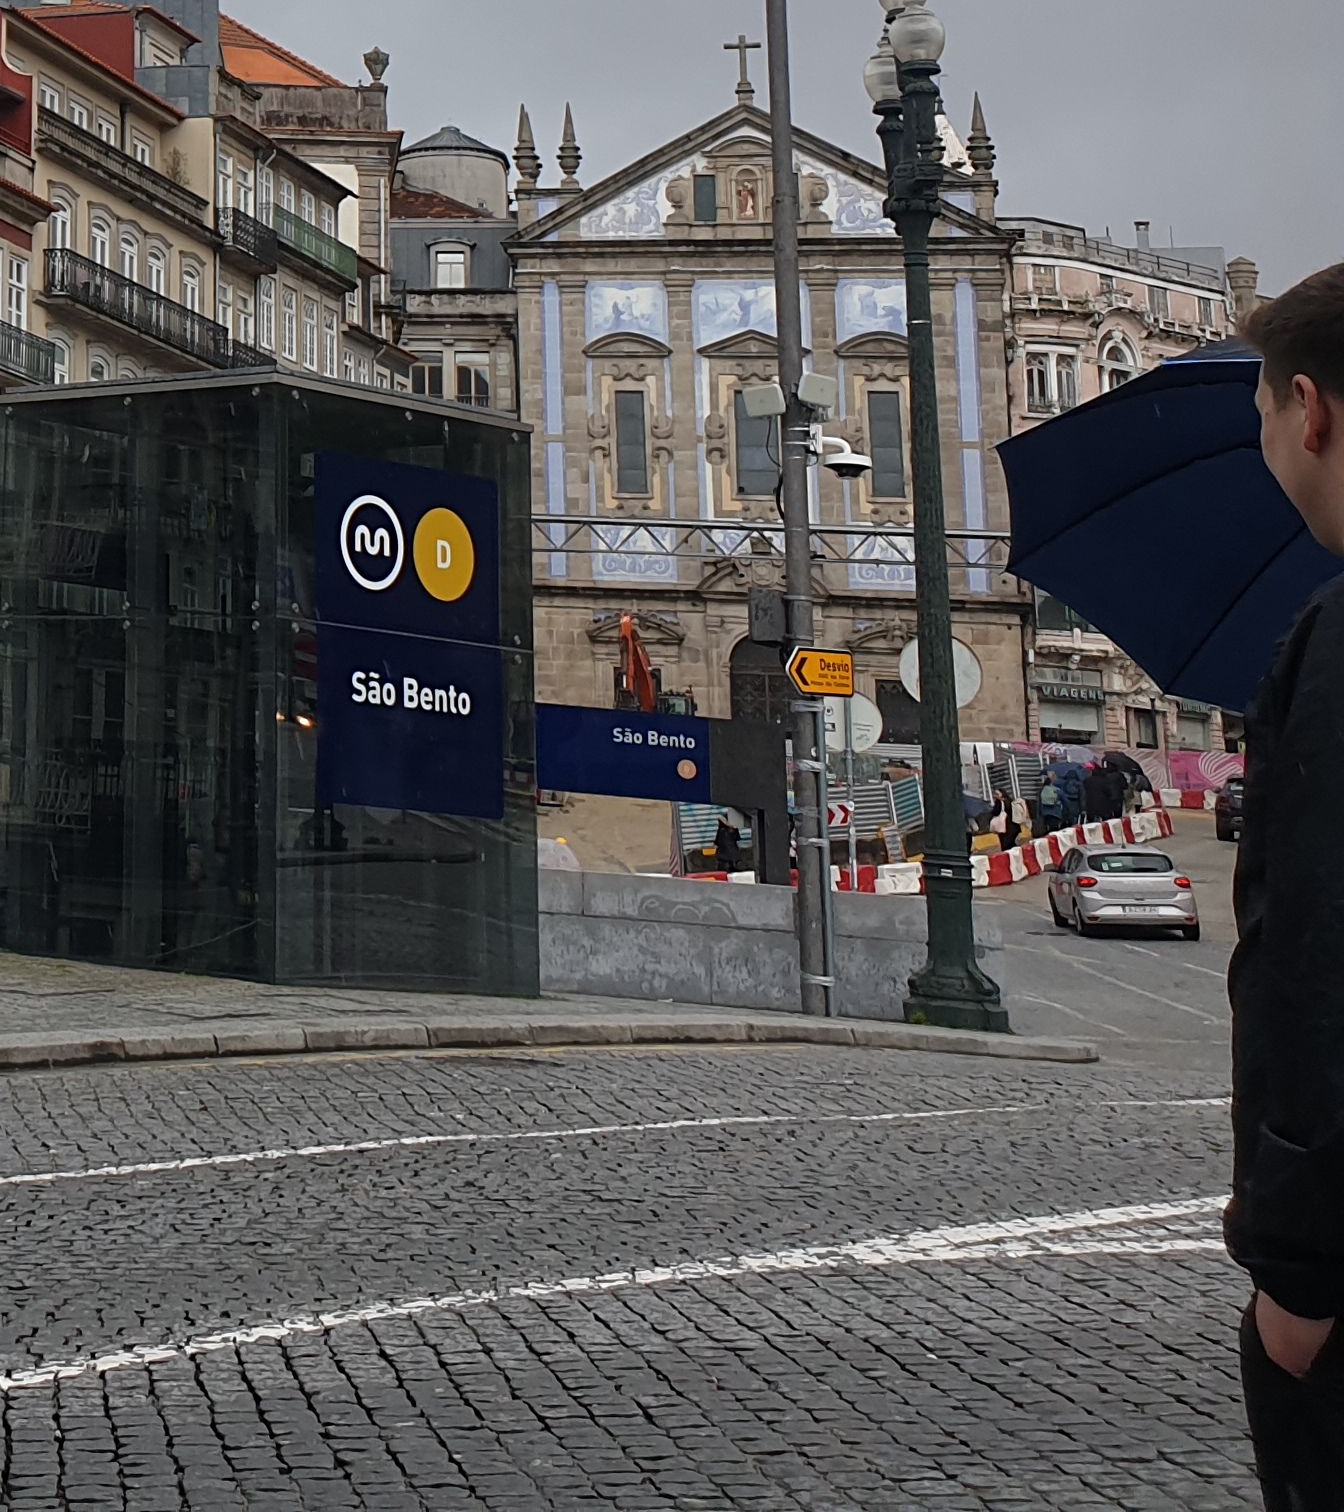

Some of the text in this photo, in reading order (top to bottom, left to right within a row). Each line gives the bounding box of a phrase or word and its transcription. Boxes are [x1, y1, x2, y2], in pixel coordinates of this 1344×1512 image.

[437, 539, 452, 569] D
[819, 658, 850, 673] Desvio
[351, 670, 471, 715] São Bento
[1042, 686, 1105, 701] VIAGENS
[612, 727, 696, 749] São Bento
